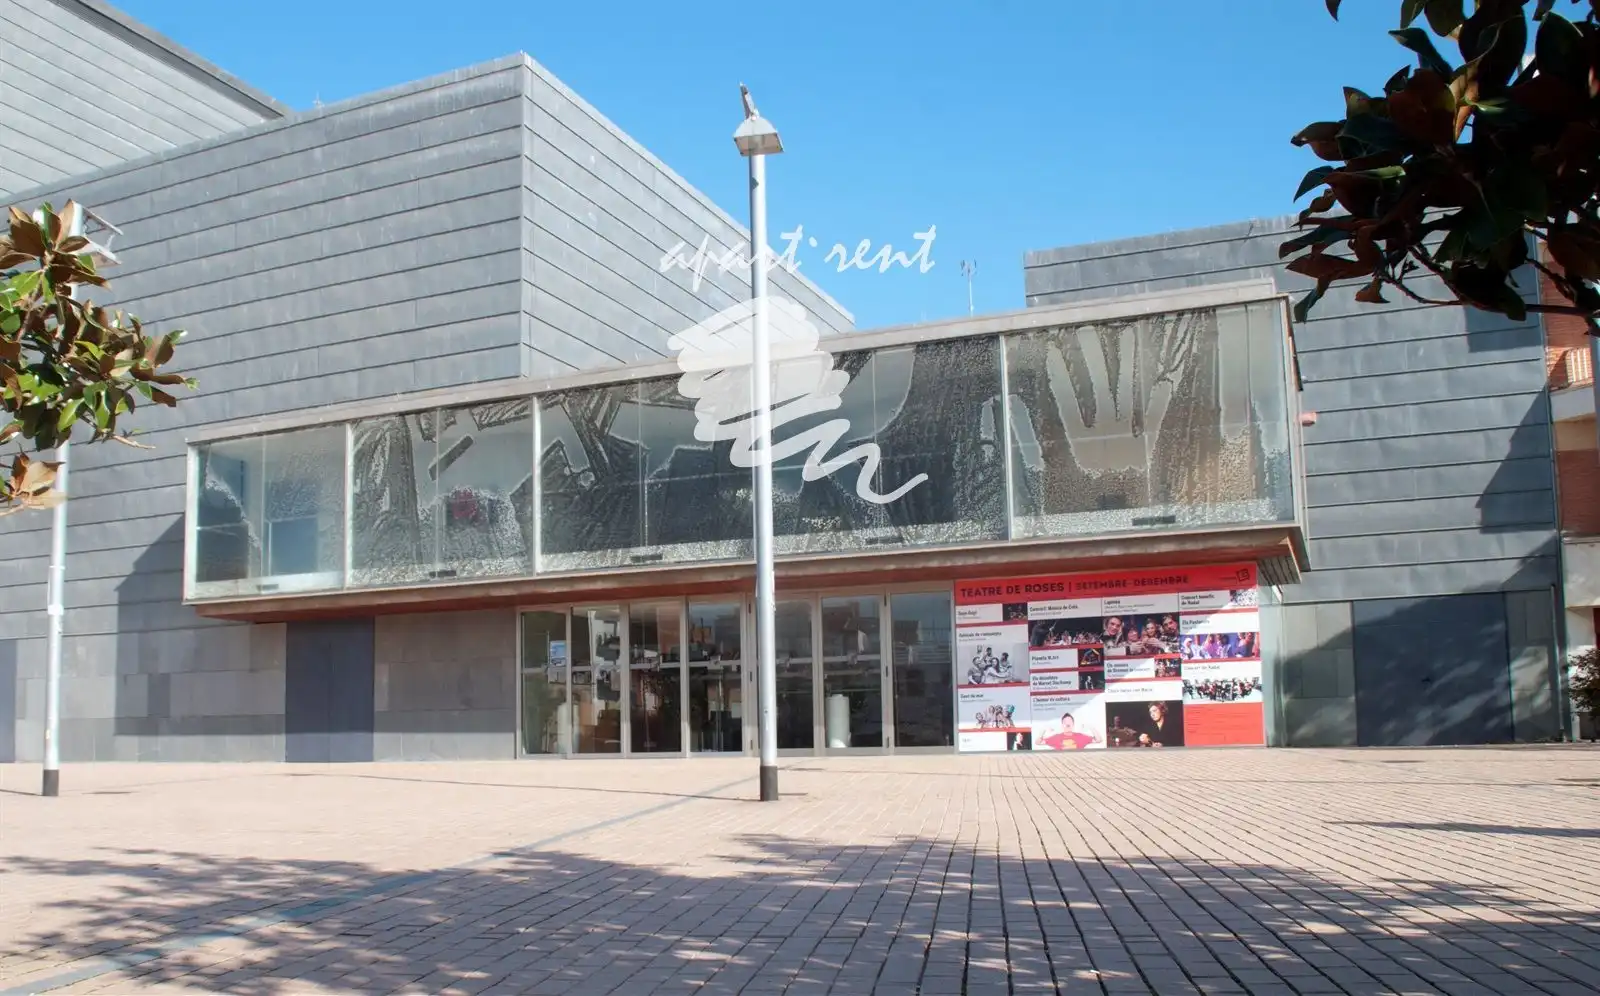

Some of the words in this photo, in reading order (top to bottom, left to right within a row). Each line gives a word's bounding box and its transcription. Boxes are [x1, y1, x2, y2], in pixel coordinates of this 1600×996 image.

[960, 585, 1003, 598] TEATRE
[1006, 584, 1021, 594] DE
[1024, 582, 1065, 593] ROSES
